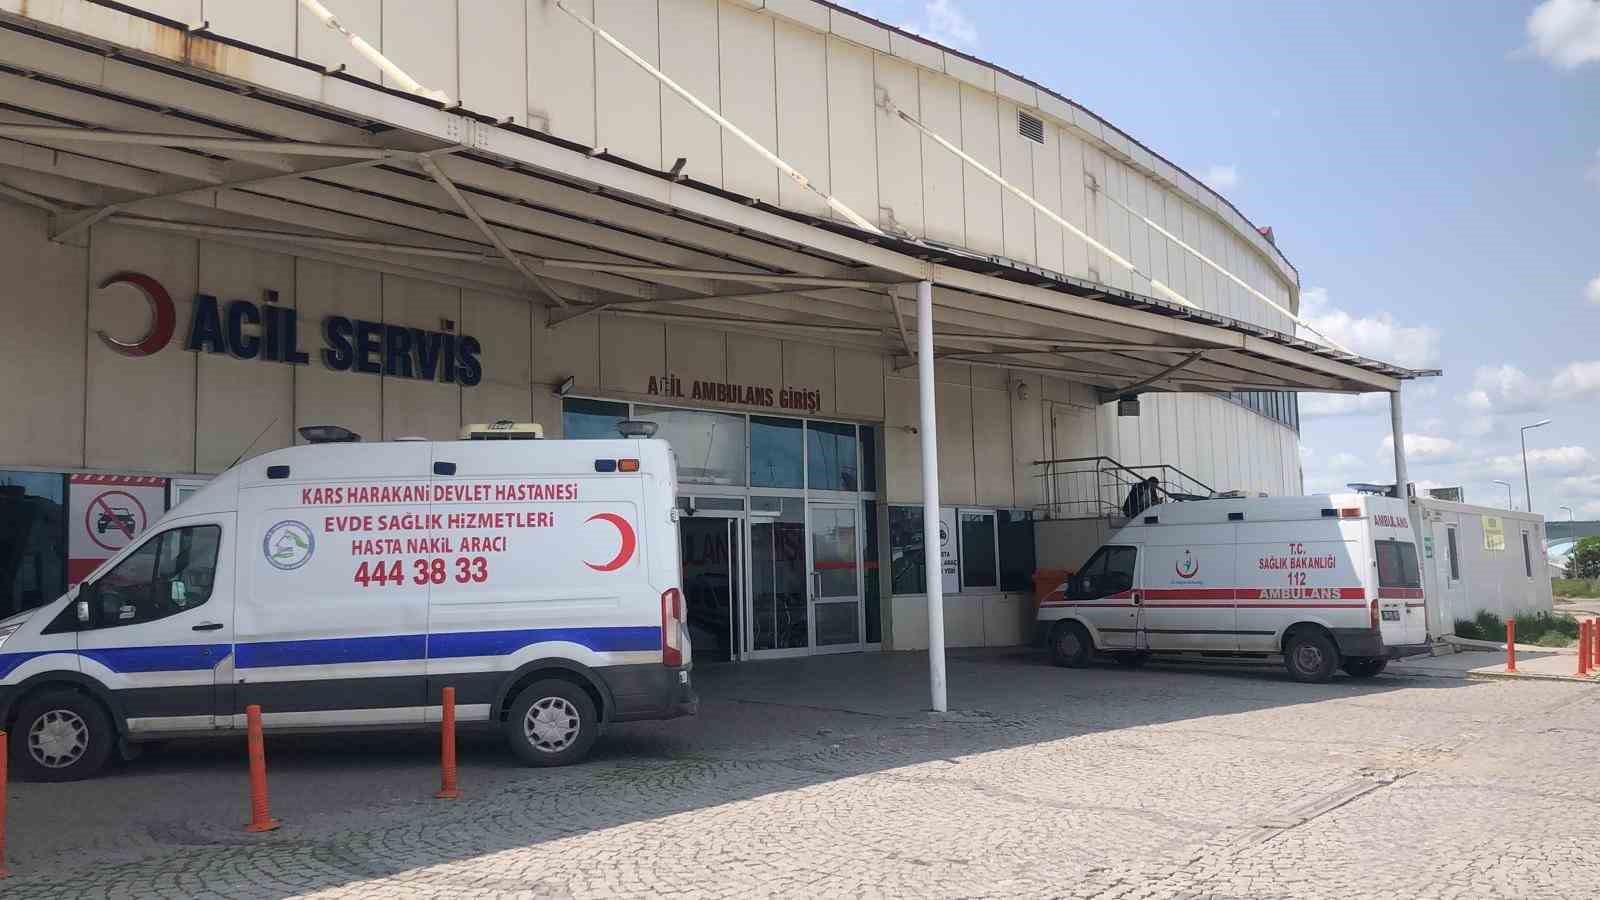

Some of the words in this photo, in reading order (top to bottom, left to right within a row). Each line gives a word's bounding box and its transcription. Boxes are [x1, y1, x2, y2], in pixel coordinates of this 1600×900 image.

[187, 289, 309, 366] ACİL
[320, 316, 482, 386] SERVİS
[692, 380, 774, 407] AMBULANS
[302, 487, 343, 505] KARS
[434, 484, 492, 502] DEVLET
[325, 516, 373, 533] EVDE
[377, 511, 443, 531] SAĞLIK
[1374, 514, 1409, 529] AMBULANS
[352, 539, 403, 556] HASTA
[460, 536, 507, 552] ARACI
[354, 560, 405, 588] 444
[413, 557, 447, 585] 38
[455, 556, 488, 583] 33
[1259, 556, 1288, 570] SAĞLIK
[1290, 554, 1336, 569] BAKANLIĞI
[1287, 571, 1307, 586] 112
[1258, 588, 1342, 600] AMBULANS
